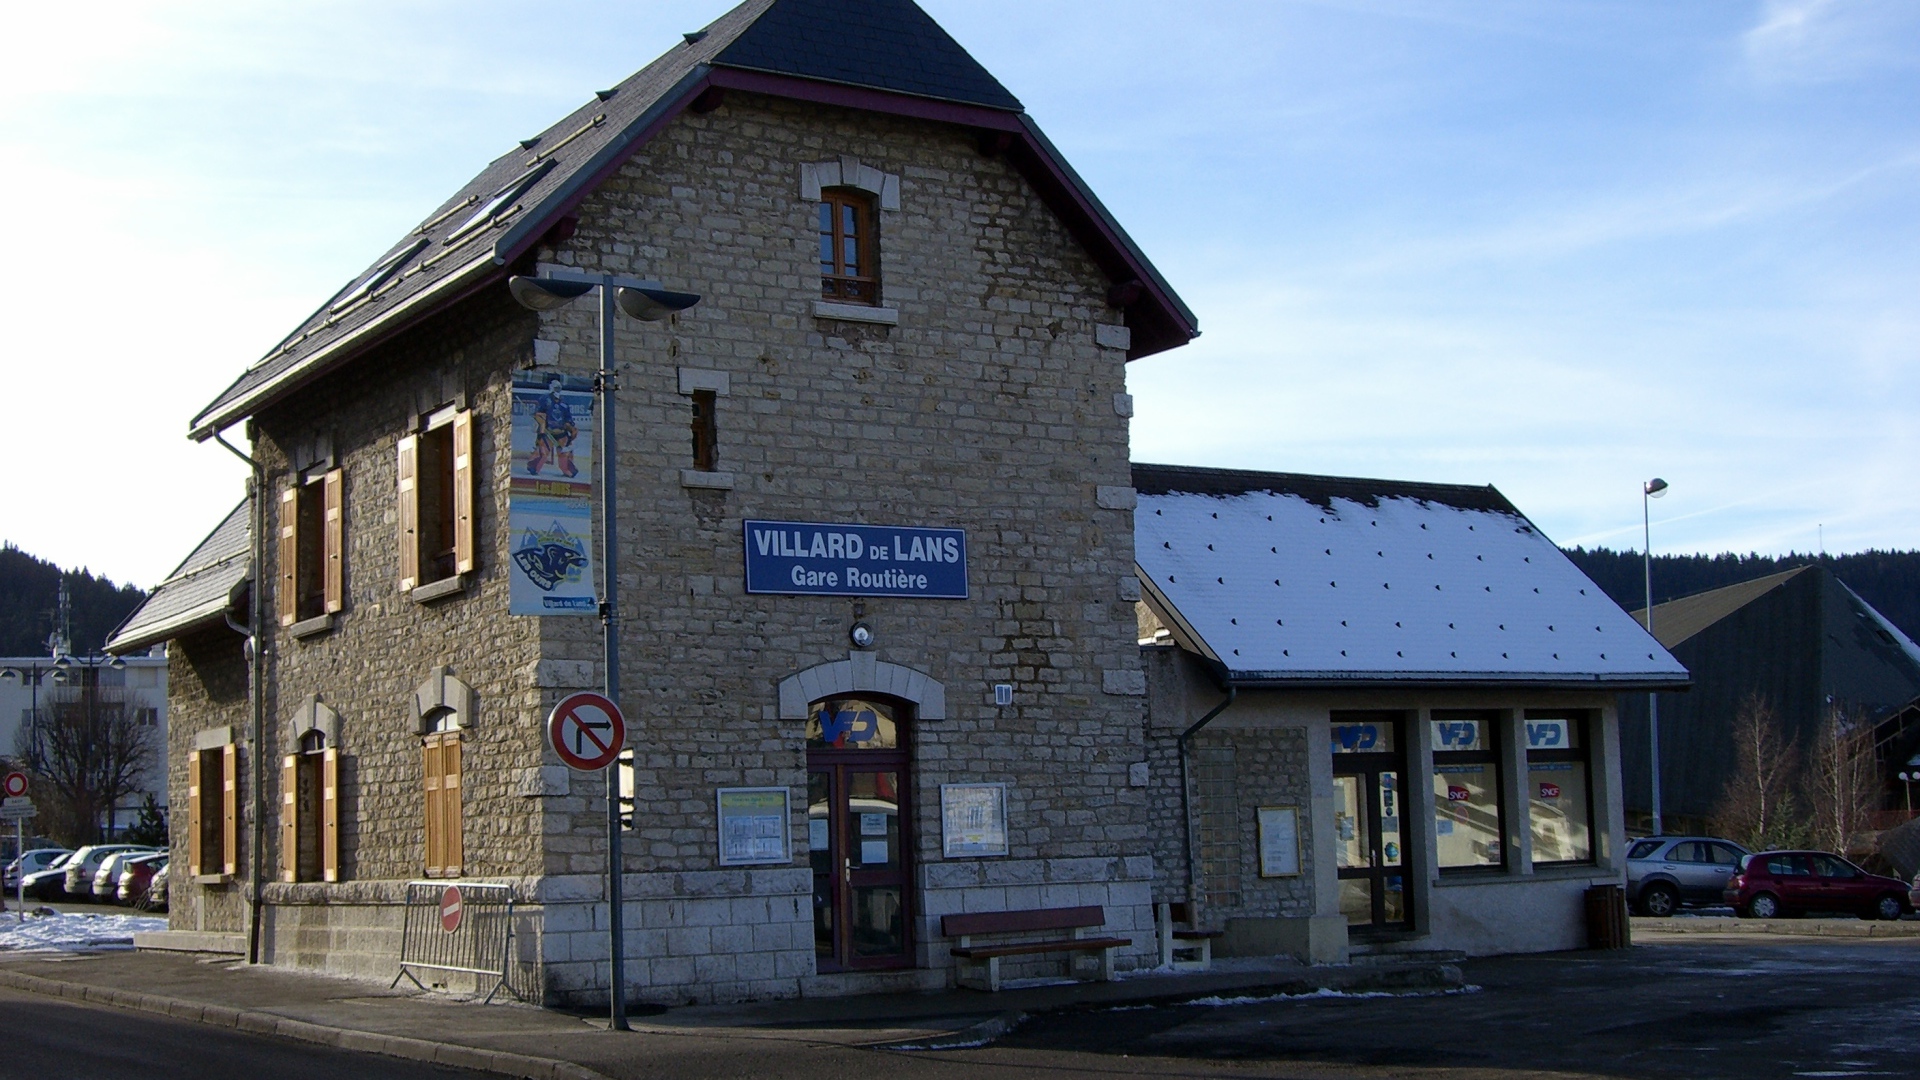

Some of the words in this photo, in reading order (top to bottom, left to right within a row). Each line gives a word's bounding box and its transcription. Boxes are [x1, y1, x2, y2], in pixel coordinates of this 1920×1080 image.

[753, 529, 864, 559] VILLARD
[869, 545, 889, 560] DE
[894, 535, 959, 563] LANS
[791, 565, 838, 587] Gare
[846, 567, 928, 589] Routière
[1438, 722, 1475, 746] VFD
[1527, 723, 1561, 746] VFD
[1449, 790, 1469, 800] SNCF
[1541, 787, 1560, 797] SNCF
